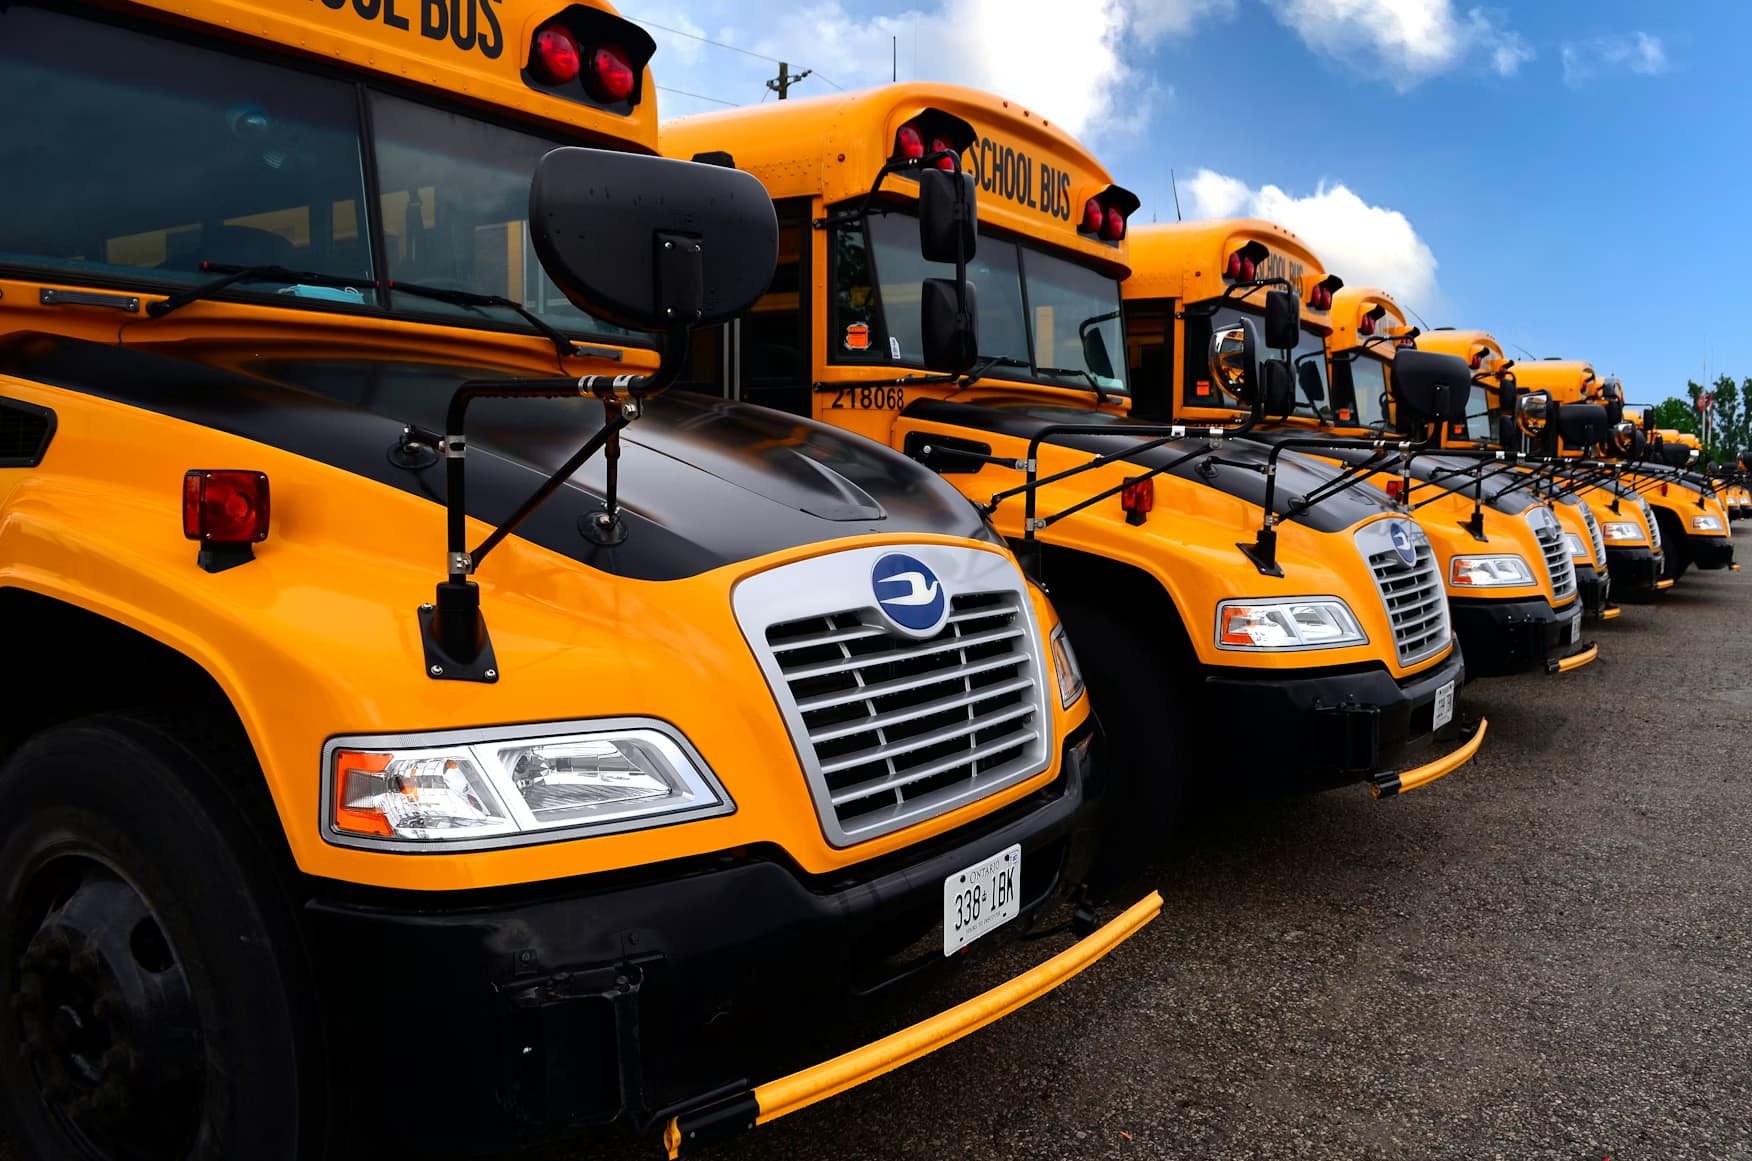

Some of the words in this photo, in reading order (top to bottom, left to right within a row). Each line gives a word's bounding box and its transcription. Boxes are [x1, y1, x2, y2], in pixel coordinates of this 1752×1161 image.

[420, 0, 504, 60] BUS
[968, 136, 1037, 209] SCHOOL
[1040, 162, 1071, 222] BUS
[832, 386, 904, 410] 218068
[955, 884, 981, 931] 338
[991, 866, 1015, 912] 1BK
